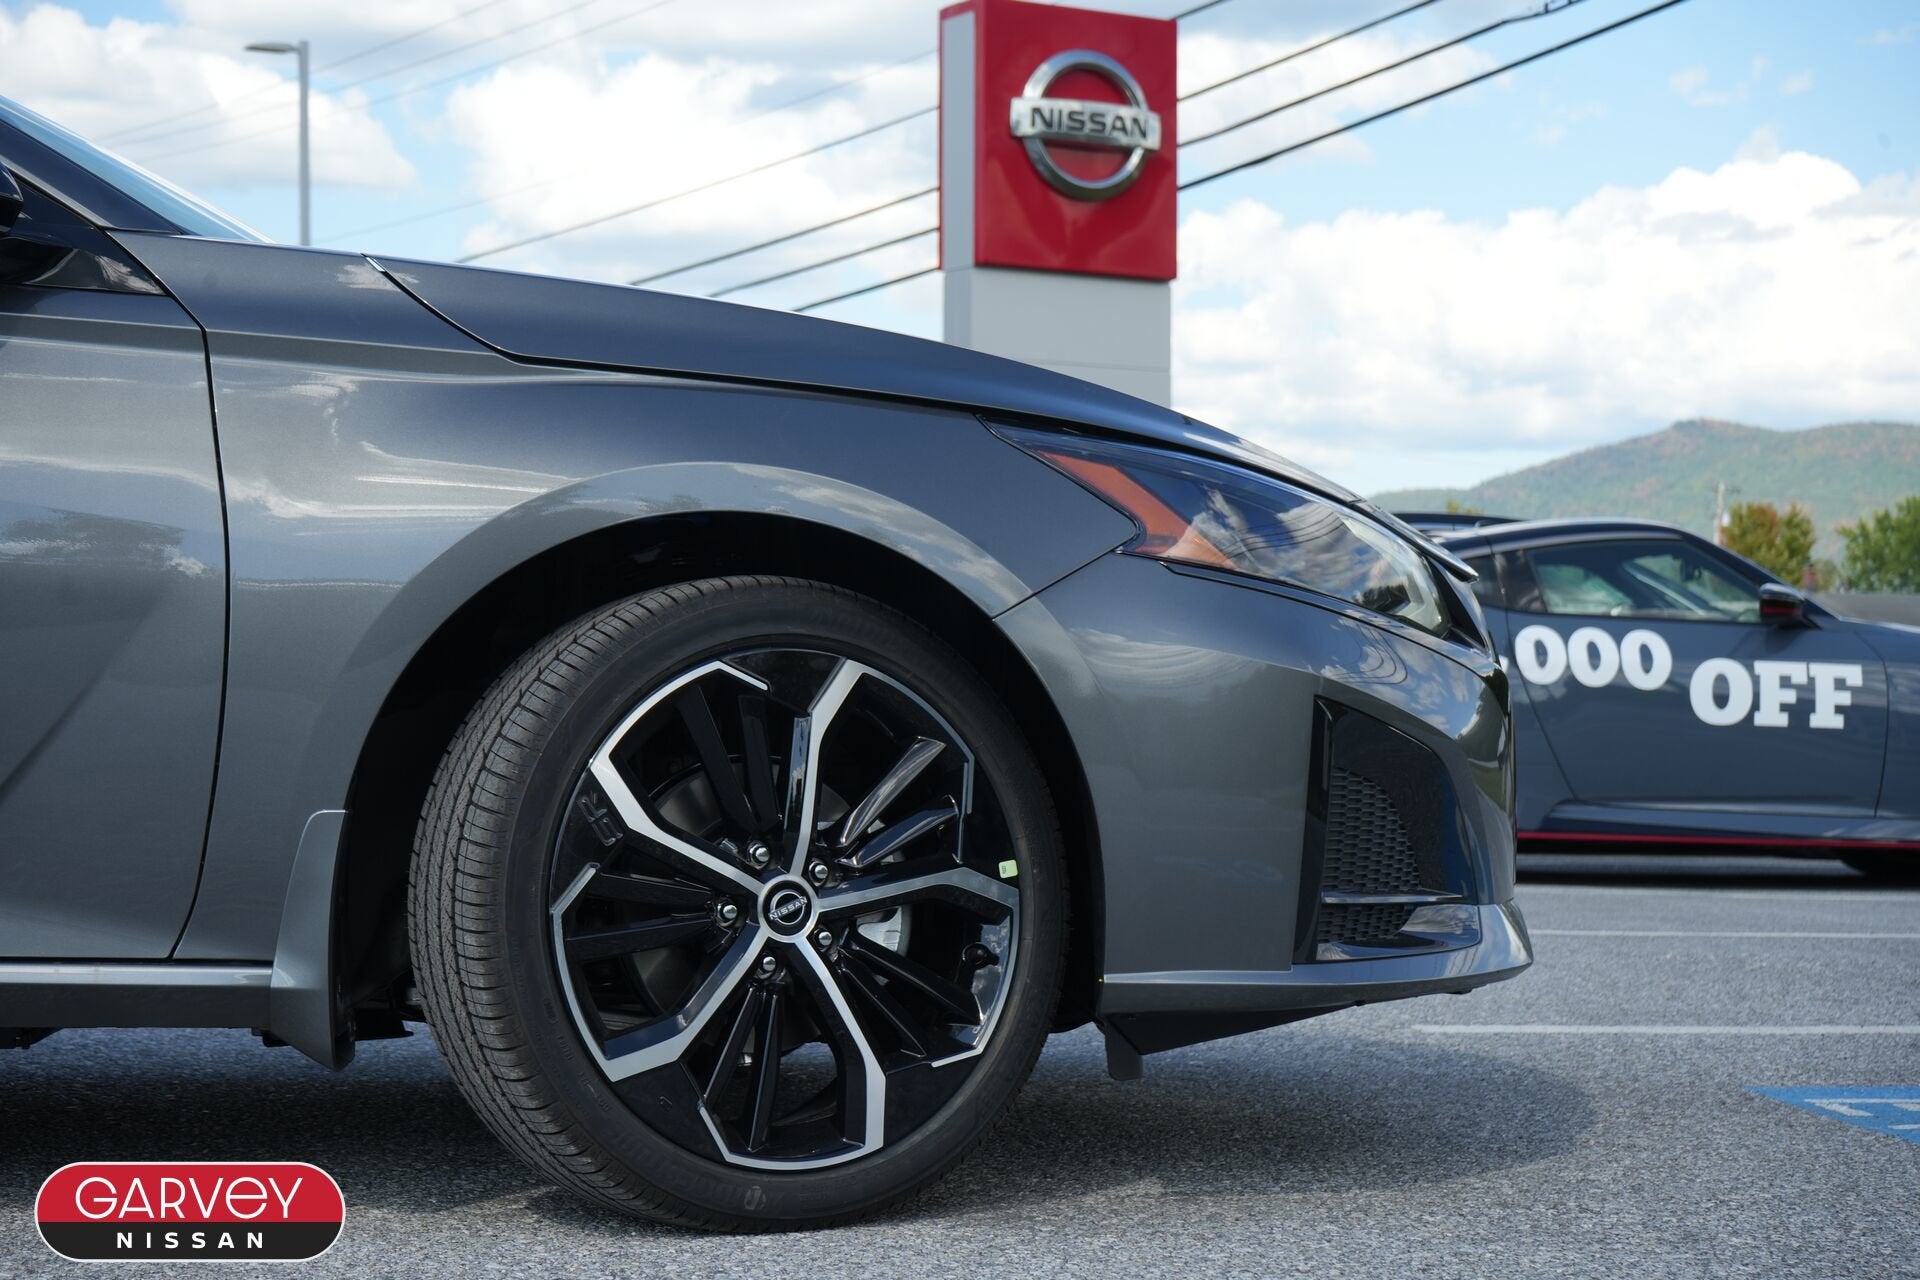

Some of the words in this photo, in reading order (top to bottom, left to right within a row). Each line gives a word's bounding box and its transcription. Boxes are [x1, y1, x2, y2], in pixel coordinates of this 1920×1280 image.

[1031, 107, 1147, 140] NISSAN
[1689, 657, 1863, 730] OFF
[768, 896, 807, 920] NISSAN
